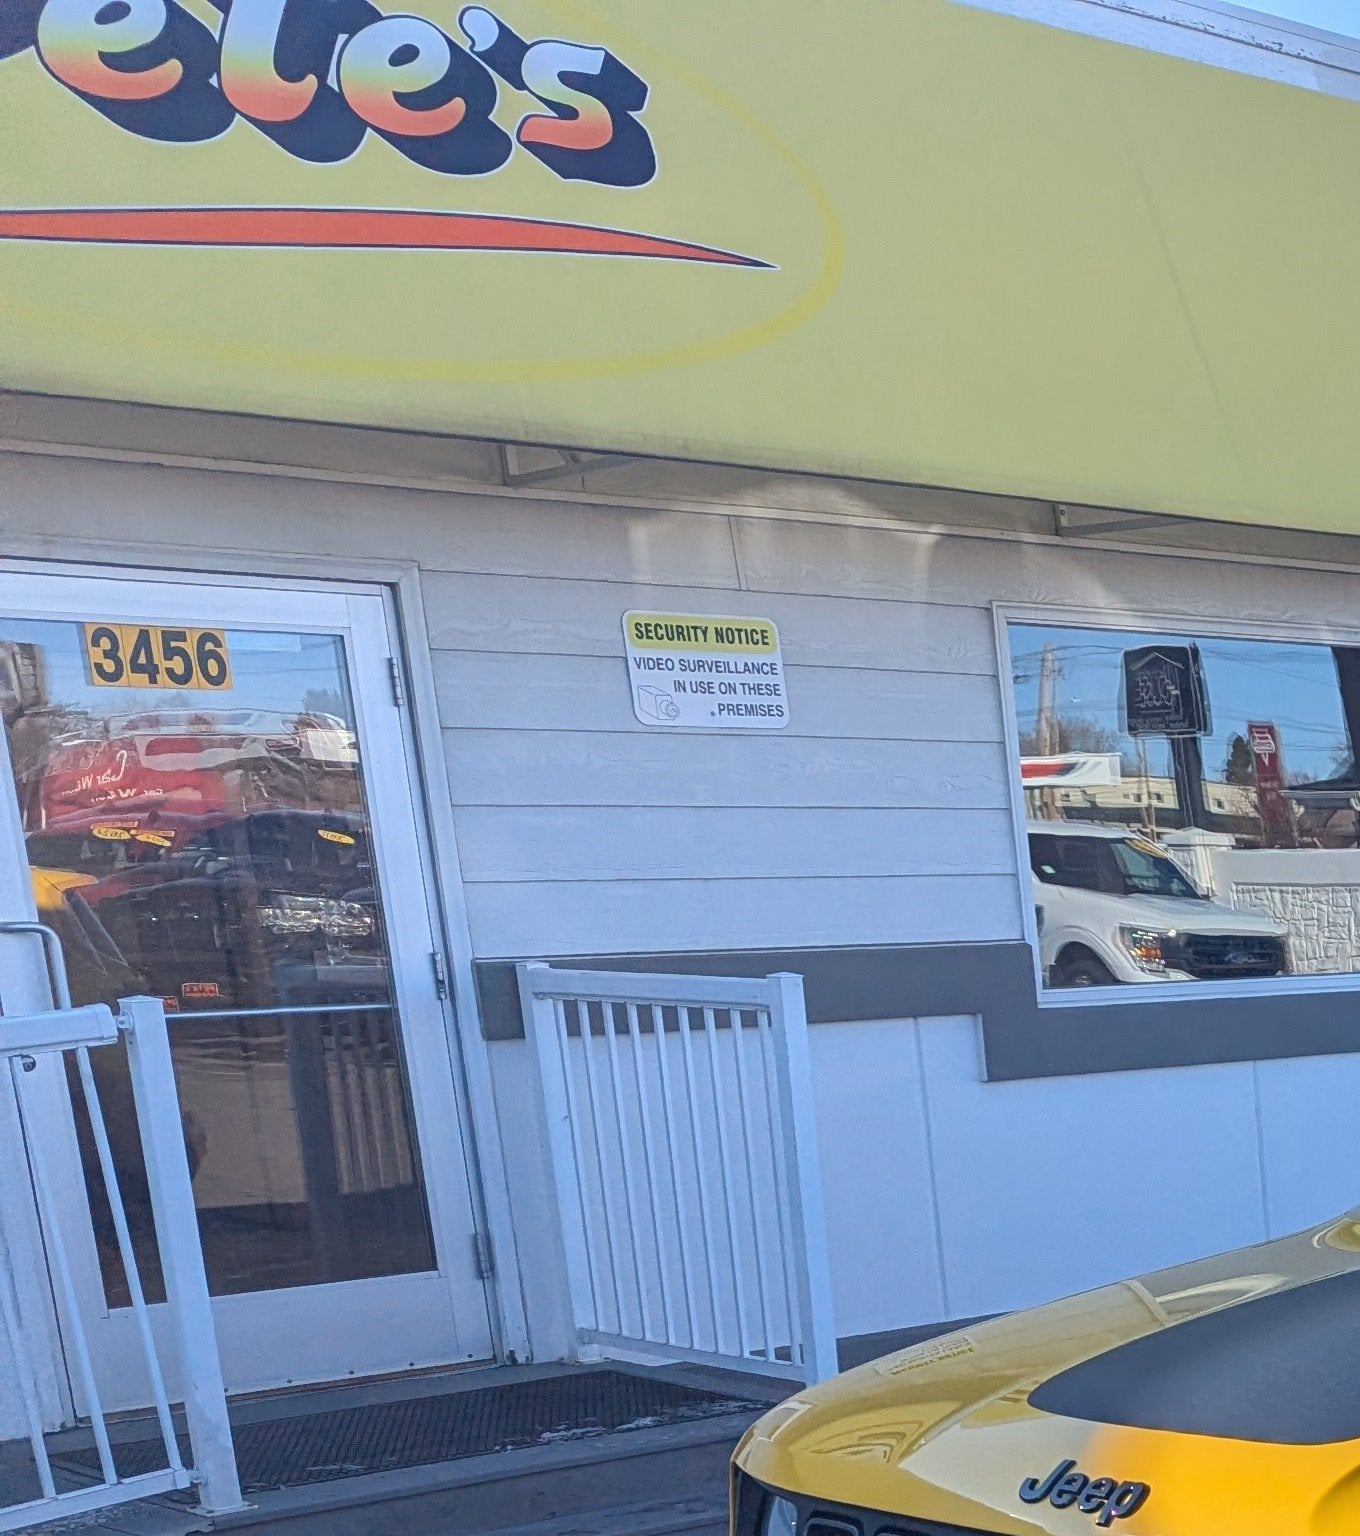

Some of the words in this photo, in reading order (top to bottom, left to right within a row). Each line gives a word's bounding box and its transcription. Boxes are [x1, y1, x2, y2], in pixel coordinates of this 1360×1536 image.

[634, 622, 709, 643] SECURITY
[714, 626, 770, 646] NOTICE
[91, 626, 227, 687] 3456
[633, 656, 675, 671] VIDEO
[679, 658, 779, 675] SURVEILLANCE
[673, 680, 686, 693] IN
[690, 680, 715, 694] USE
[718, 682, 737, 695] ON
[739, 682, 782, 697] THESE
[717, 702, 784, 718] PREMISES
[1018, 1458, 1152, 1529] Jeep
